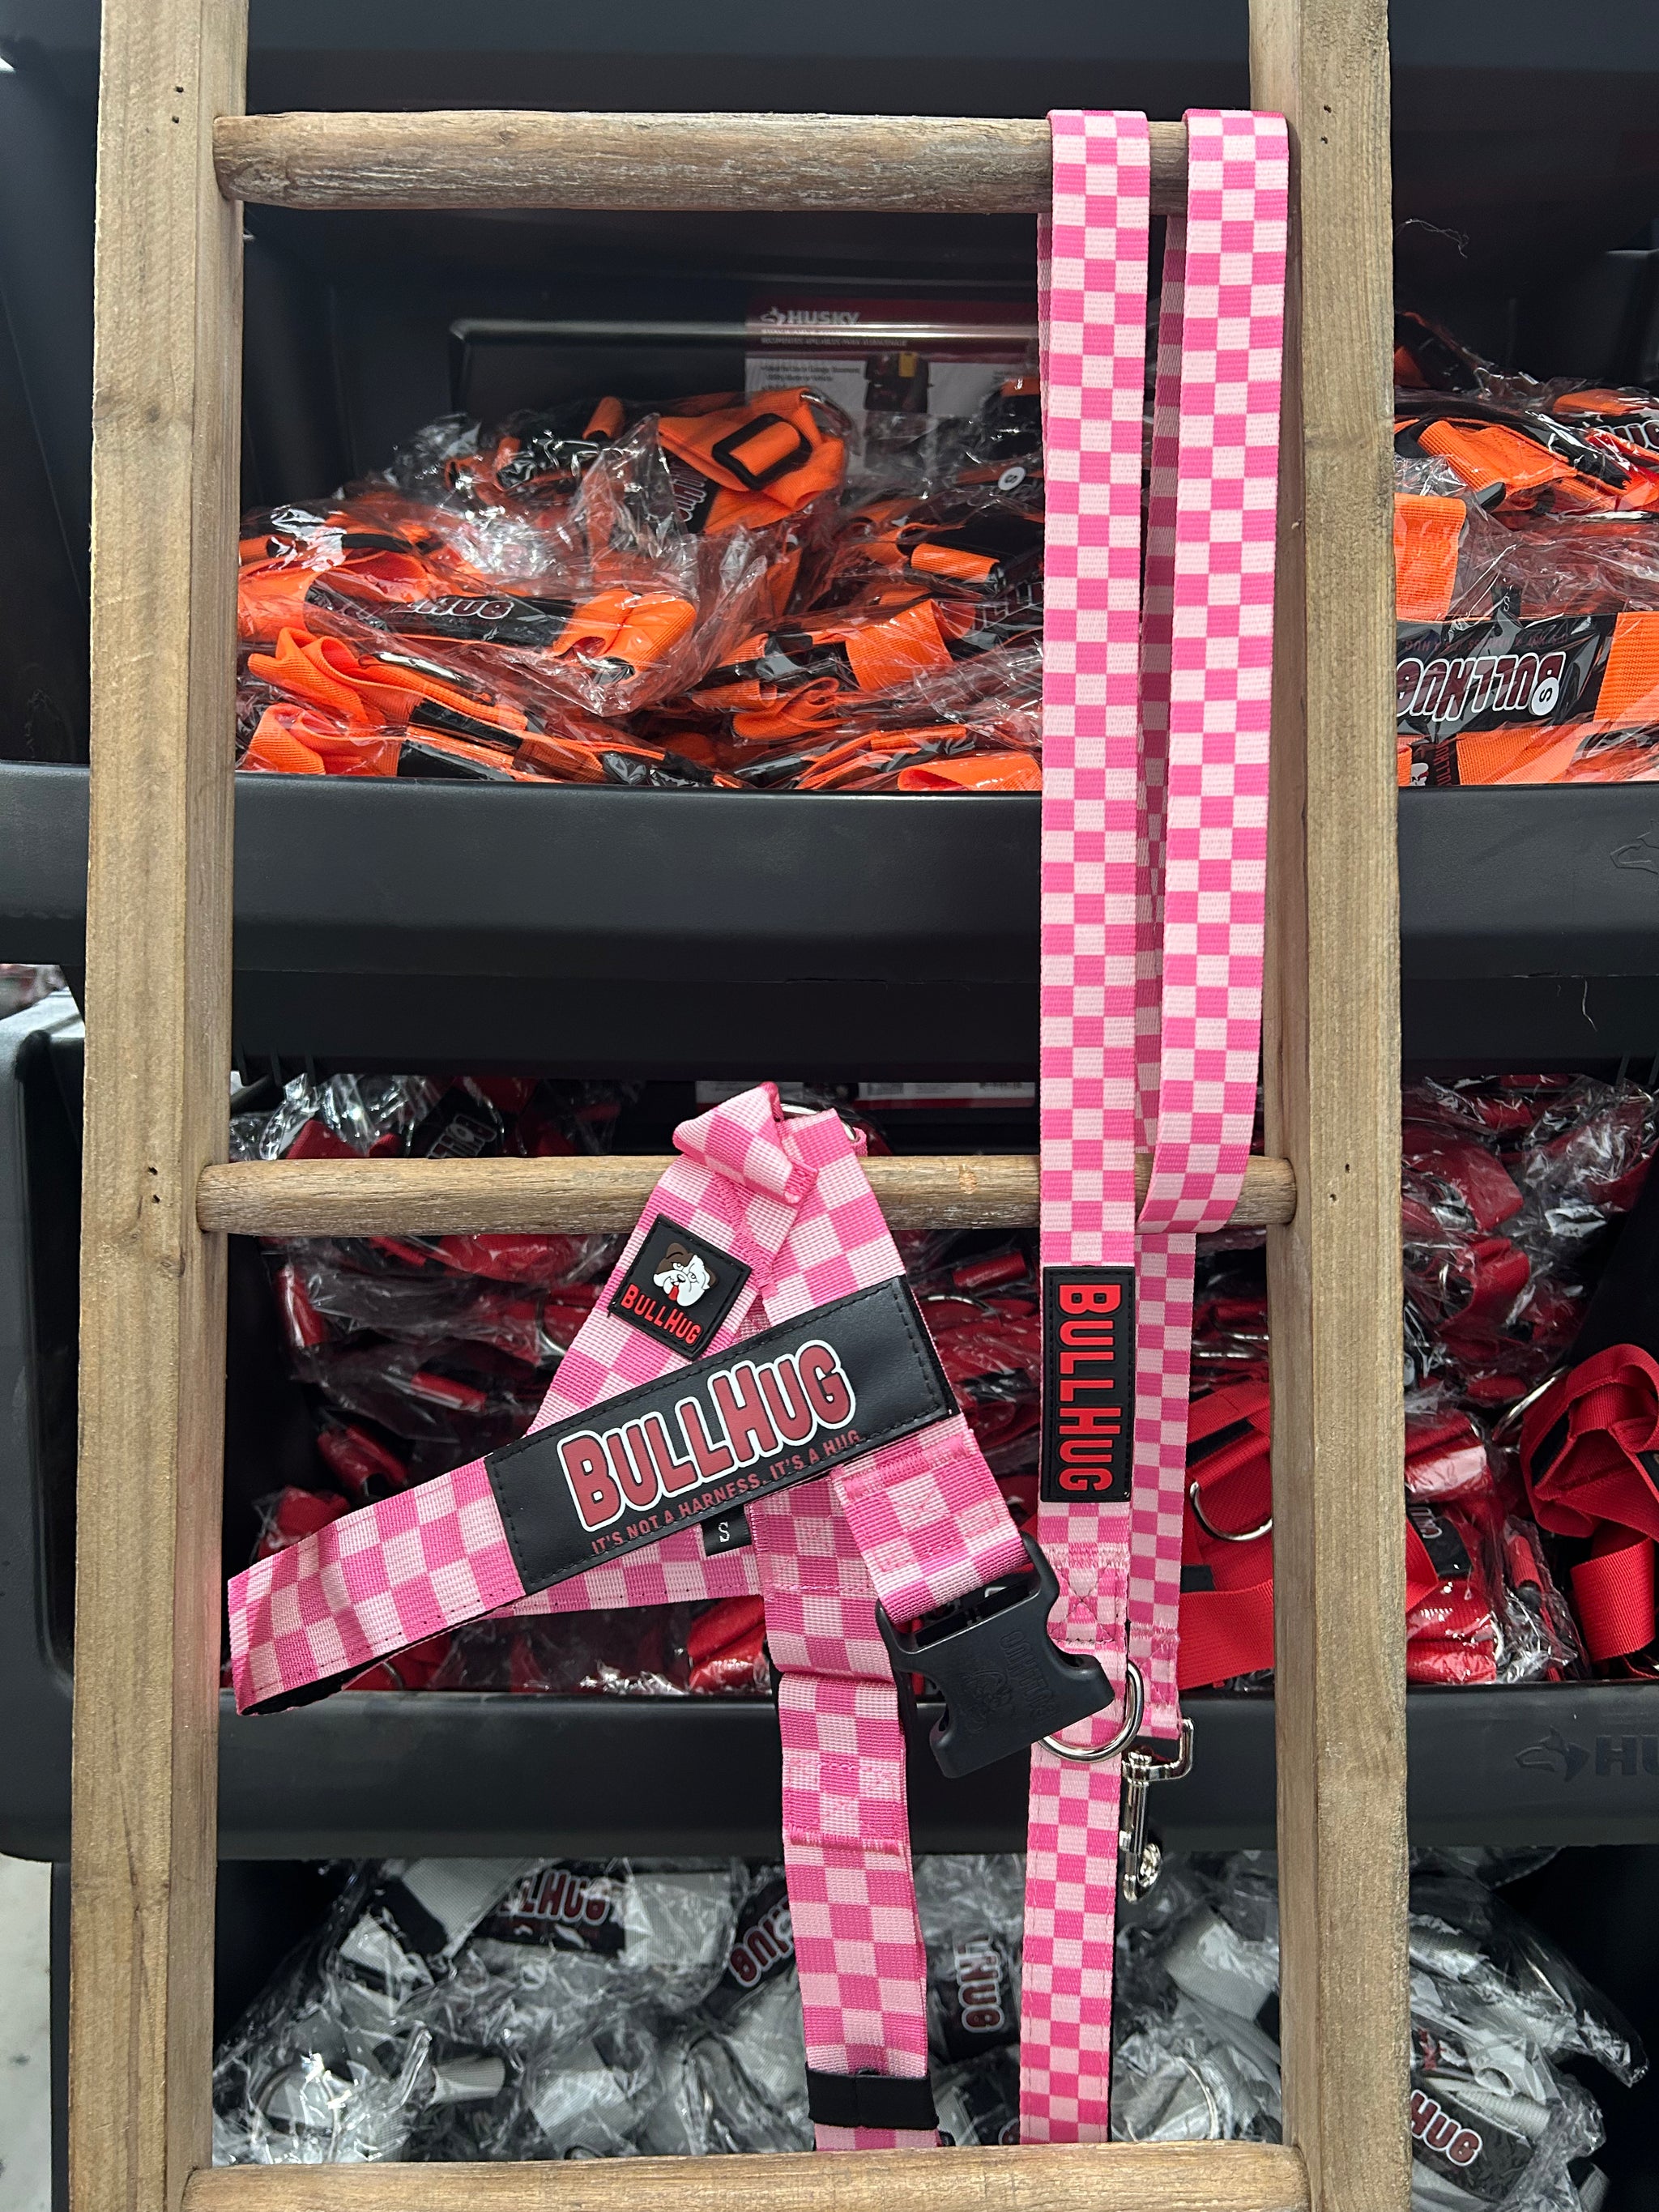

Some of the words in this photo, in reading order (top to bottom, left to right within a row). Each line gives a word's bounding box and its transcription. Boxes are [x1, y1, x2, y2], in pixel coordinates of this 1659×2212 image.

[788, 309, 860, 324] HUSKY
[1538, 687, 1553, 702] S
[621, 1285, 702, 1345] BULLHUG
[1059, 1285, 1121, 1491] BULLHUG
[557, 1339, 857, 1532] BULLHUG
[591, 1532, 623, 1554] IT'S
[626, 1514, 659, 1540] NOT
[664, 1509, 675, 1523] A
[677, 1472, 766, 1518] HARNESS.
[770, 1454, 803, 1479] IT'S
[808, 1447, 820, 1464] A
[718, 1521, 731, 1543] S
